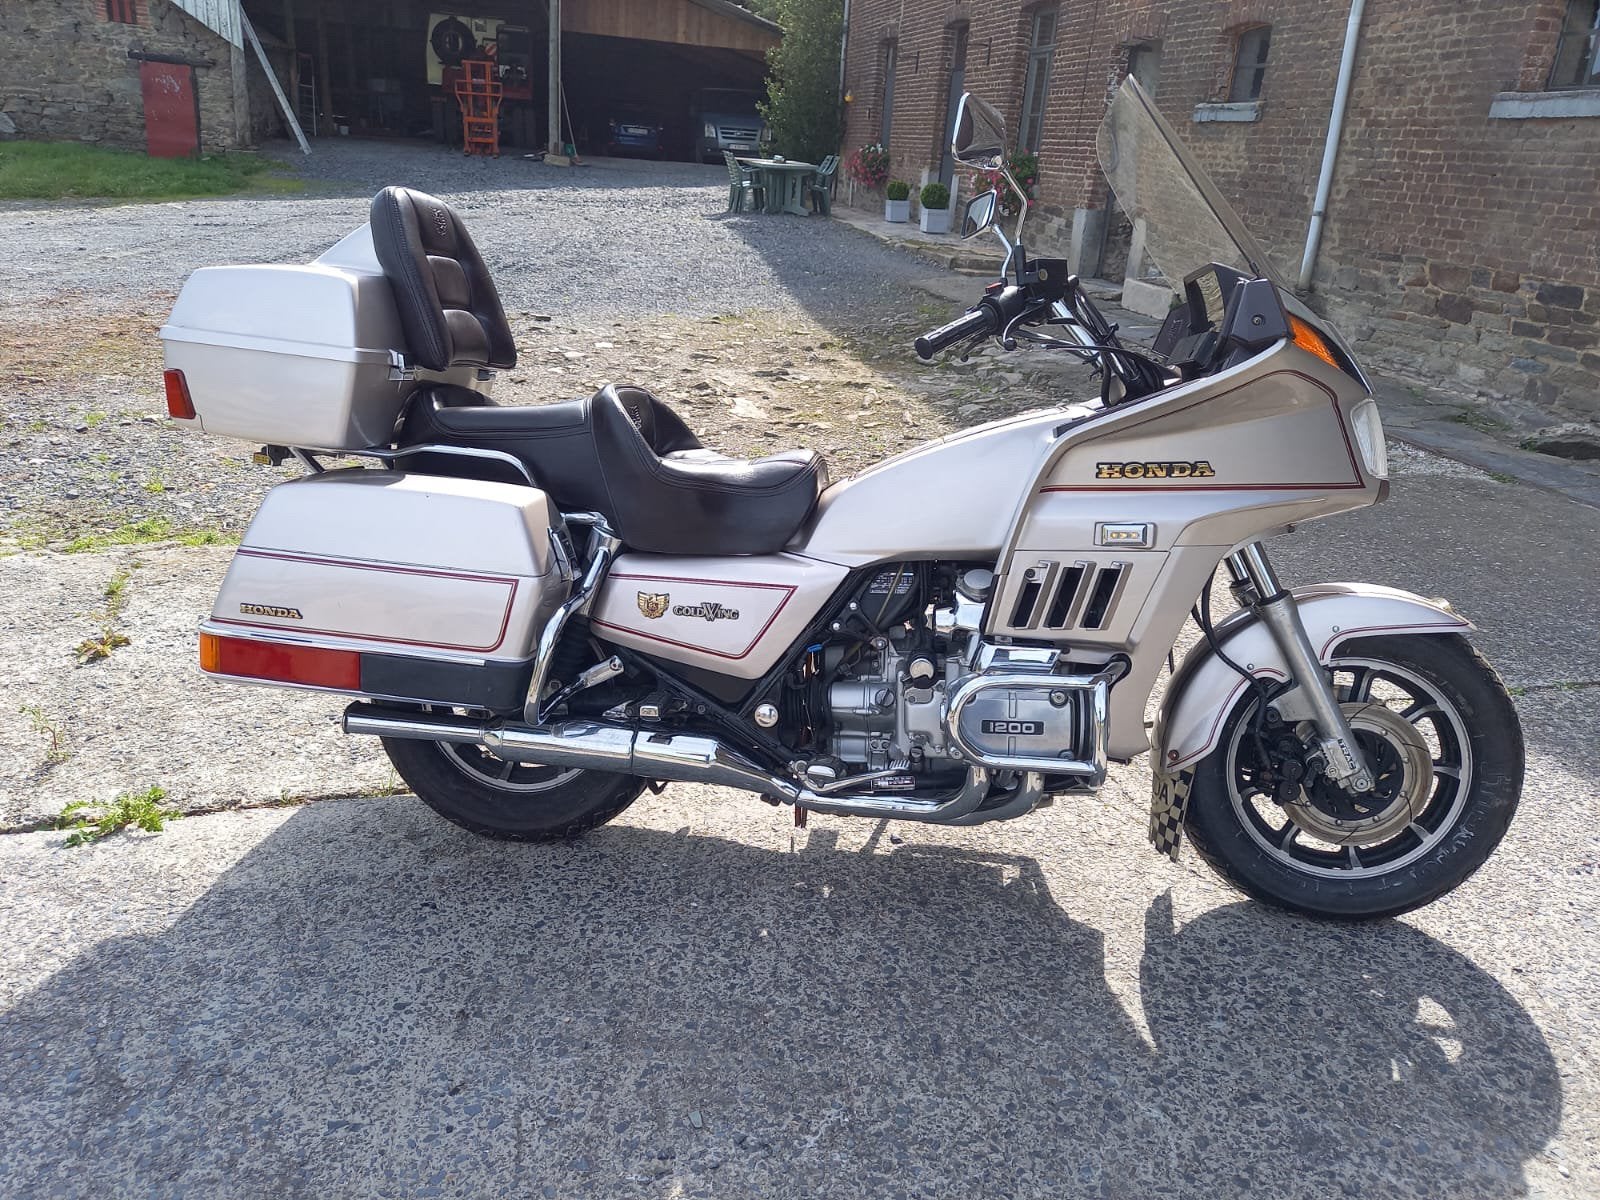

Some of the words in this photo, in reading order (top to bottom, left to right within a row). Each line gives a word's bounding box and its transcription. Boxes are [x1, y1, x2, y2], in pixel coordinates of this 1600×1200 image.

[1096, 461, 1215, 479] HONDA
[240, 603, 303, 619] HONDA
[989, 722, 1035, 734] 1200
